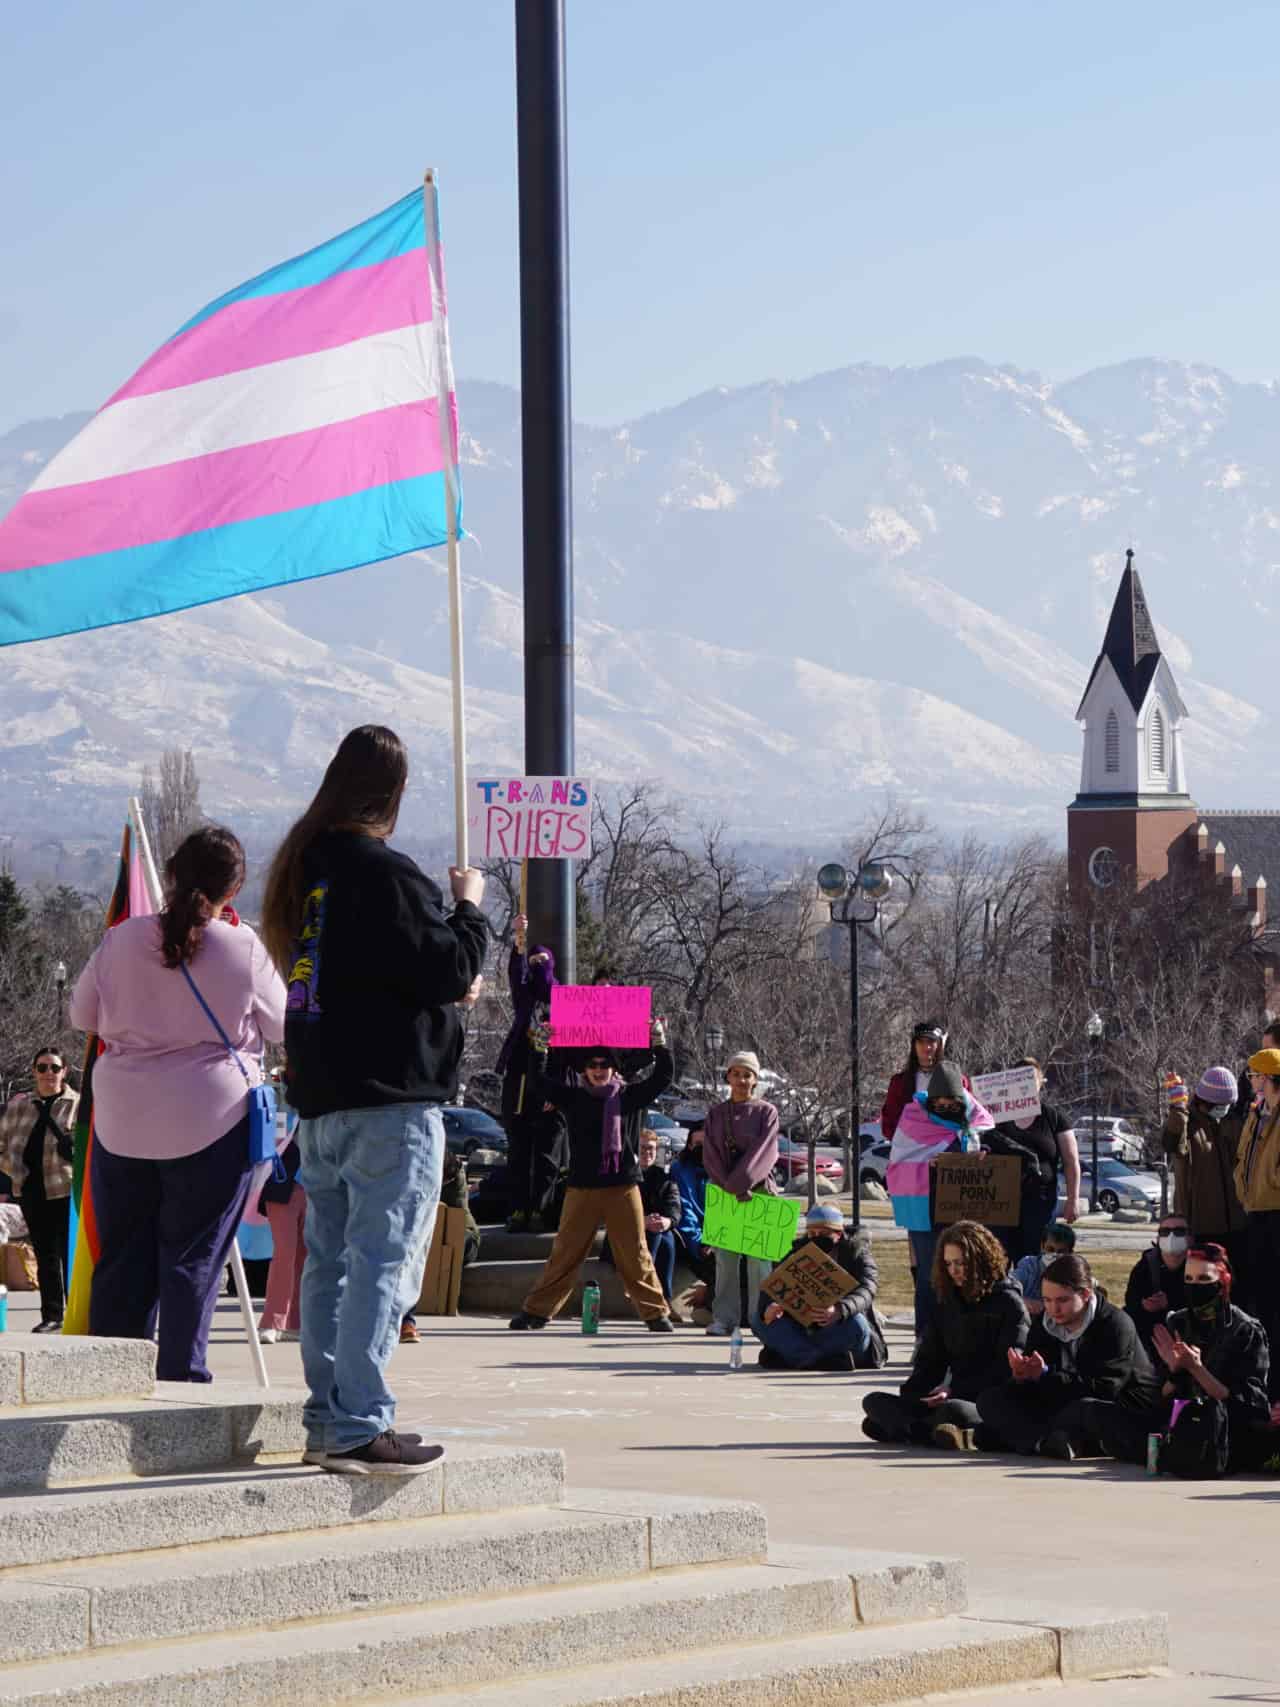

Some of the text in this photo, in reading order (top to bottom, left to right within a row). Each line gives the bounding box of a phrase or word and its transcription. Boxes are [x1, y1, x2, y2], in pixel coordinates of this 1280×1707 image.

[555, 987, 600, 1002] TRANS
[582, 1003, 614, 1022] ARE
[552, 1024, 604, 1046] HUMAN
[1004, 1096, 1038, 1112] RIGHTS
[940, 1167, 993, 1185] TRANNY
[960, 1184, 997, 1200] PORN
[706, 1185, 794, 1229] DIVIDED
[704, 1224, 729, 1247] WE
[785, 1262, 828, 1303] DESERVE
[767, 1277, 816, 1315] EXIST
